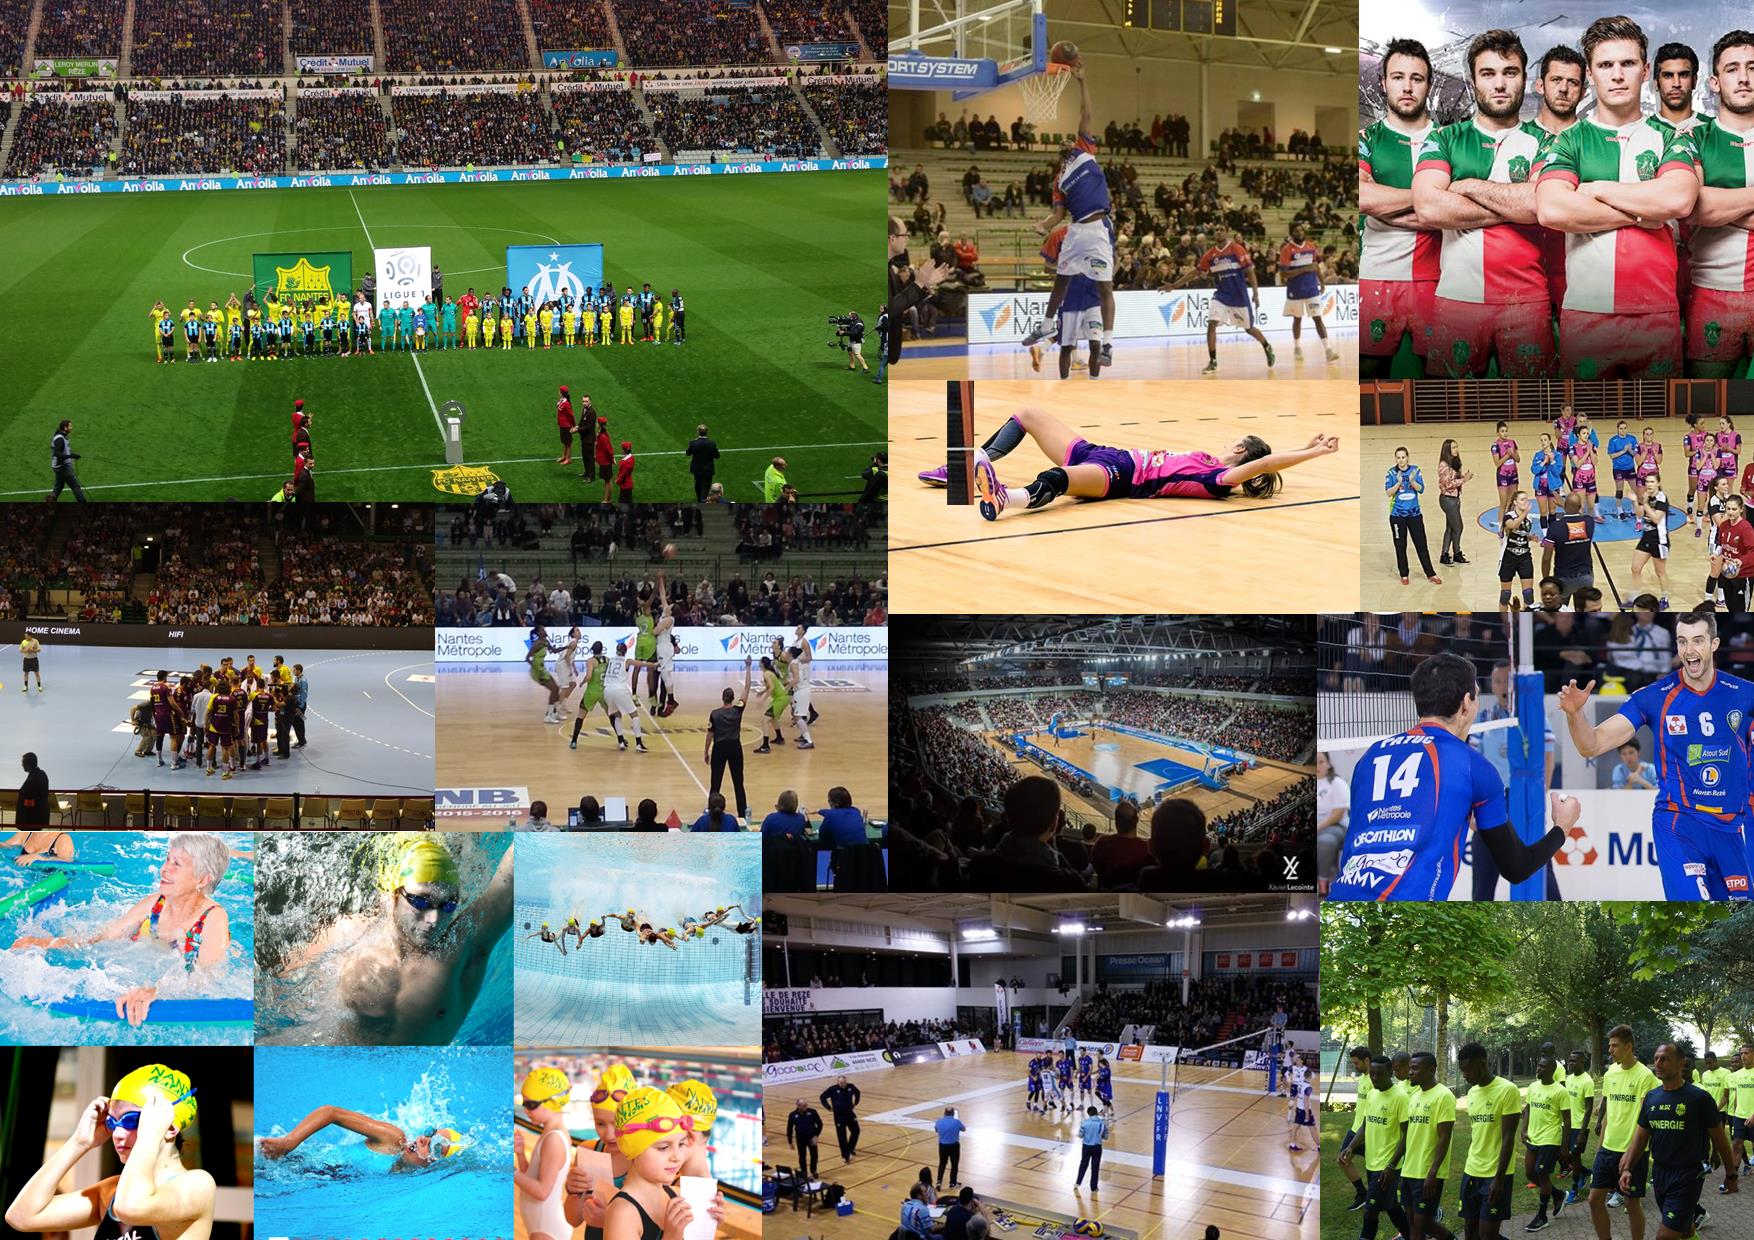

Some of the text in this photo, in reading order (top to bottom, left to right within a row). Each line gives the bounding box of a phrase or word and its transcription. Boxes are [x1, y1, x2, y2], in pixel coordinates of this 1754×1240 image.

[300, 58, 369, 67] Crédit Mutuel
[807, 76, 875, 85] Crédit Mutuel
[557, 83, 624, 91] Crédit Mutuel
[75, 93, 107, 101] Mutuel
[279, 293, 292, 302] FC
[383, 290, 417, 299] LIGUE
[25, 626, 81, 635] HOME CINEMA
[438, 633, 483, 644] Nantes
[828, 632, 871, 643] Nantes
[437, 644, 502, 658] Métropole
[217, 704, 227, 713] 23
[1698, 711, 1715, 737] 6
[1718, 748, 1729, 756] Sud
[1372, 751, 1424, 802] 14
[1353, 829, 1416, 848] DECATHLON
[1725, 878, 1747, 888] ETPO
